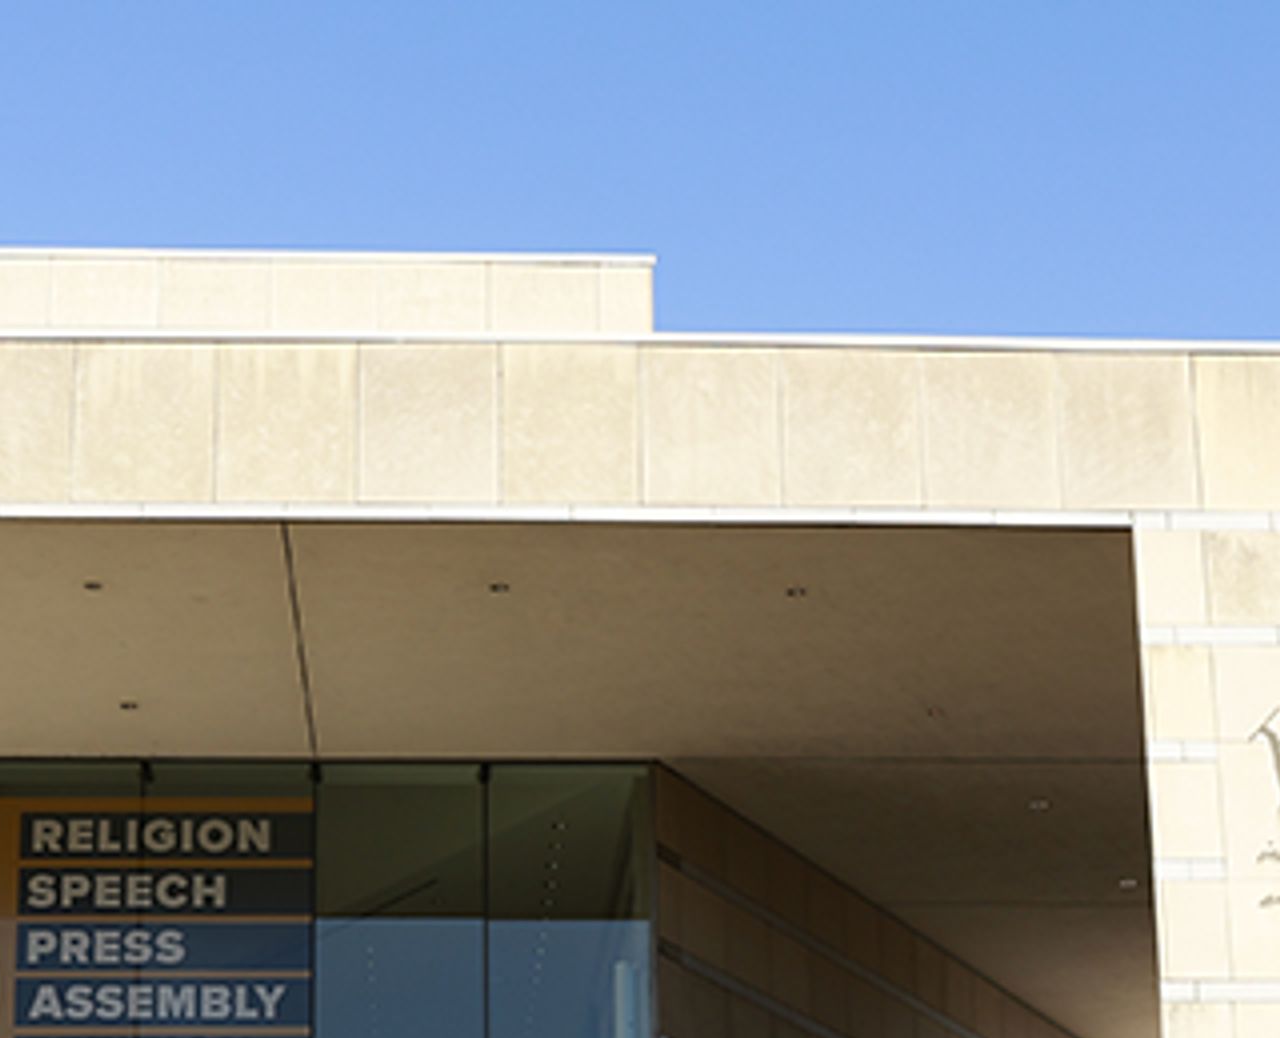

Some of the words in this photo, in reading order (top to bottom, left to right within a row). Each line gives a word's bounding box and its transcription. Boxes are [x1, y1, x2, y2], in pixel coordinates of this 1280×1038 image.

[32, 818, 271, 853] RELIGION
[26, 874, 226, 908] SPEECH
[26, 929, 186, 963] PRESS
[28, 984, 286, 1019] ASSEMBLY
